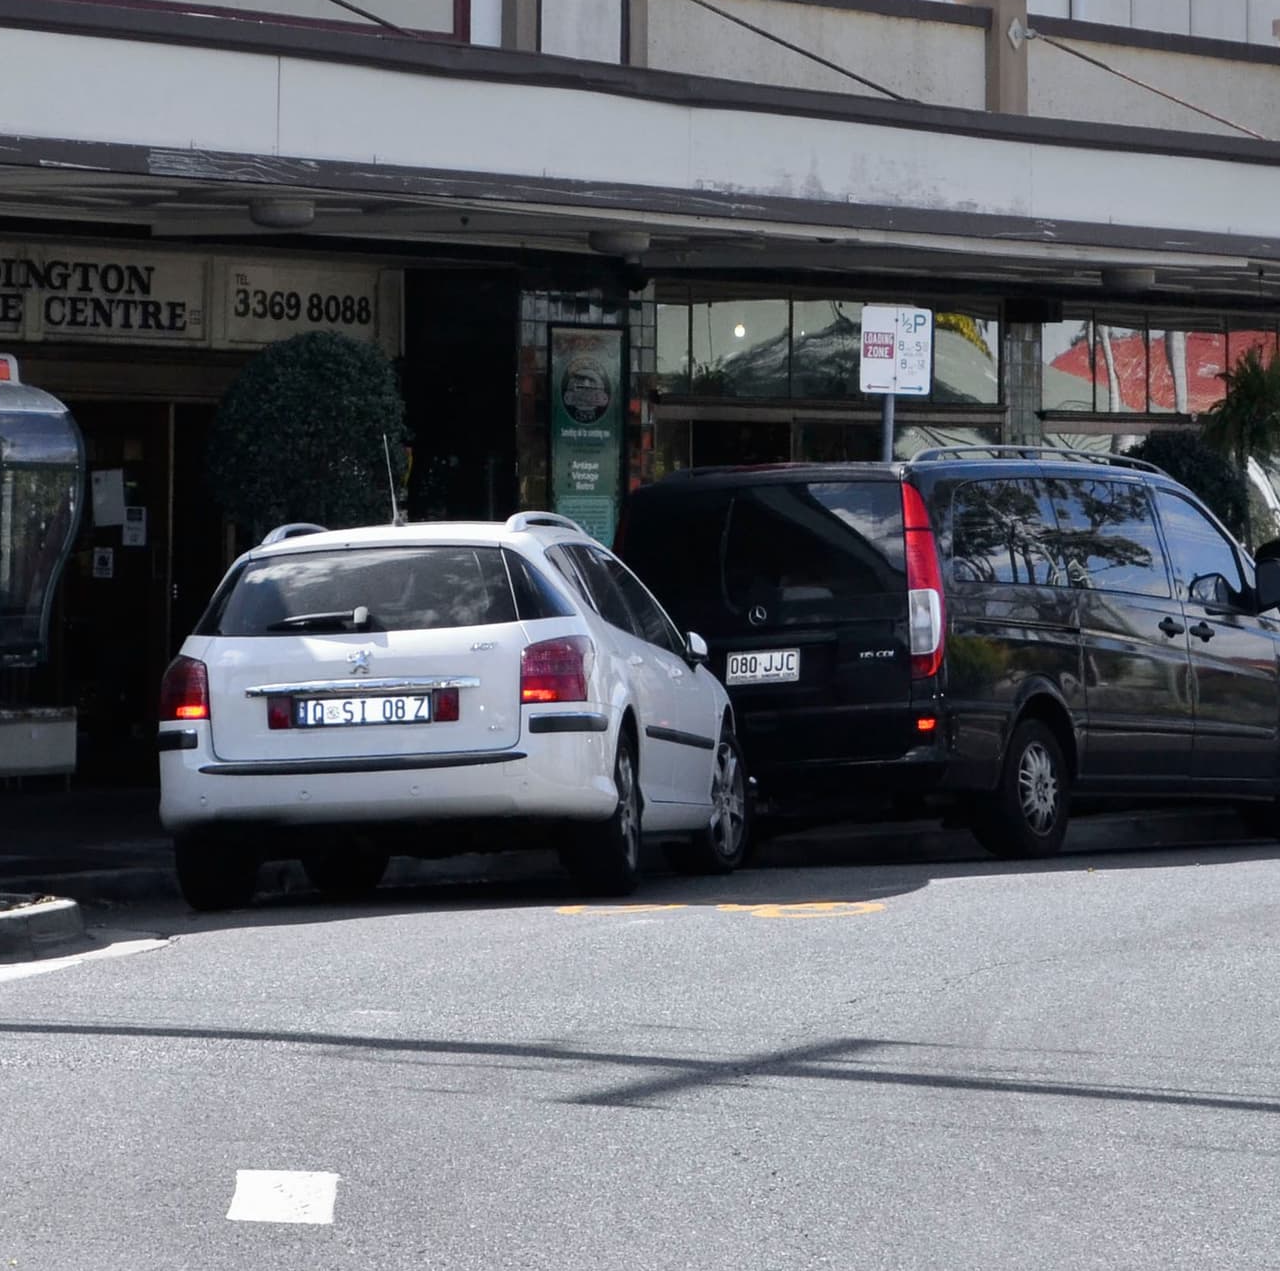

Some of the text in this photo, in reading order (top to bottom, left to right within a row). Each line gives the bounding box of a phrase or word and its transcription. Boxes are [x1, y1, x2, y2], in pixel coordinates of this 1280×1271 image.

[44, 296, 188, 331] CENTRE
[234, 288, 301, 321] 3369
[306, 292, 371, 325] 8088
[864, 333, 894, 345] LOADING
[867, 346, 890, 358] ZONE
